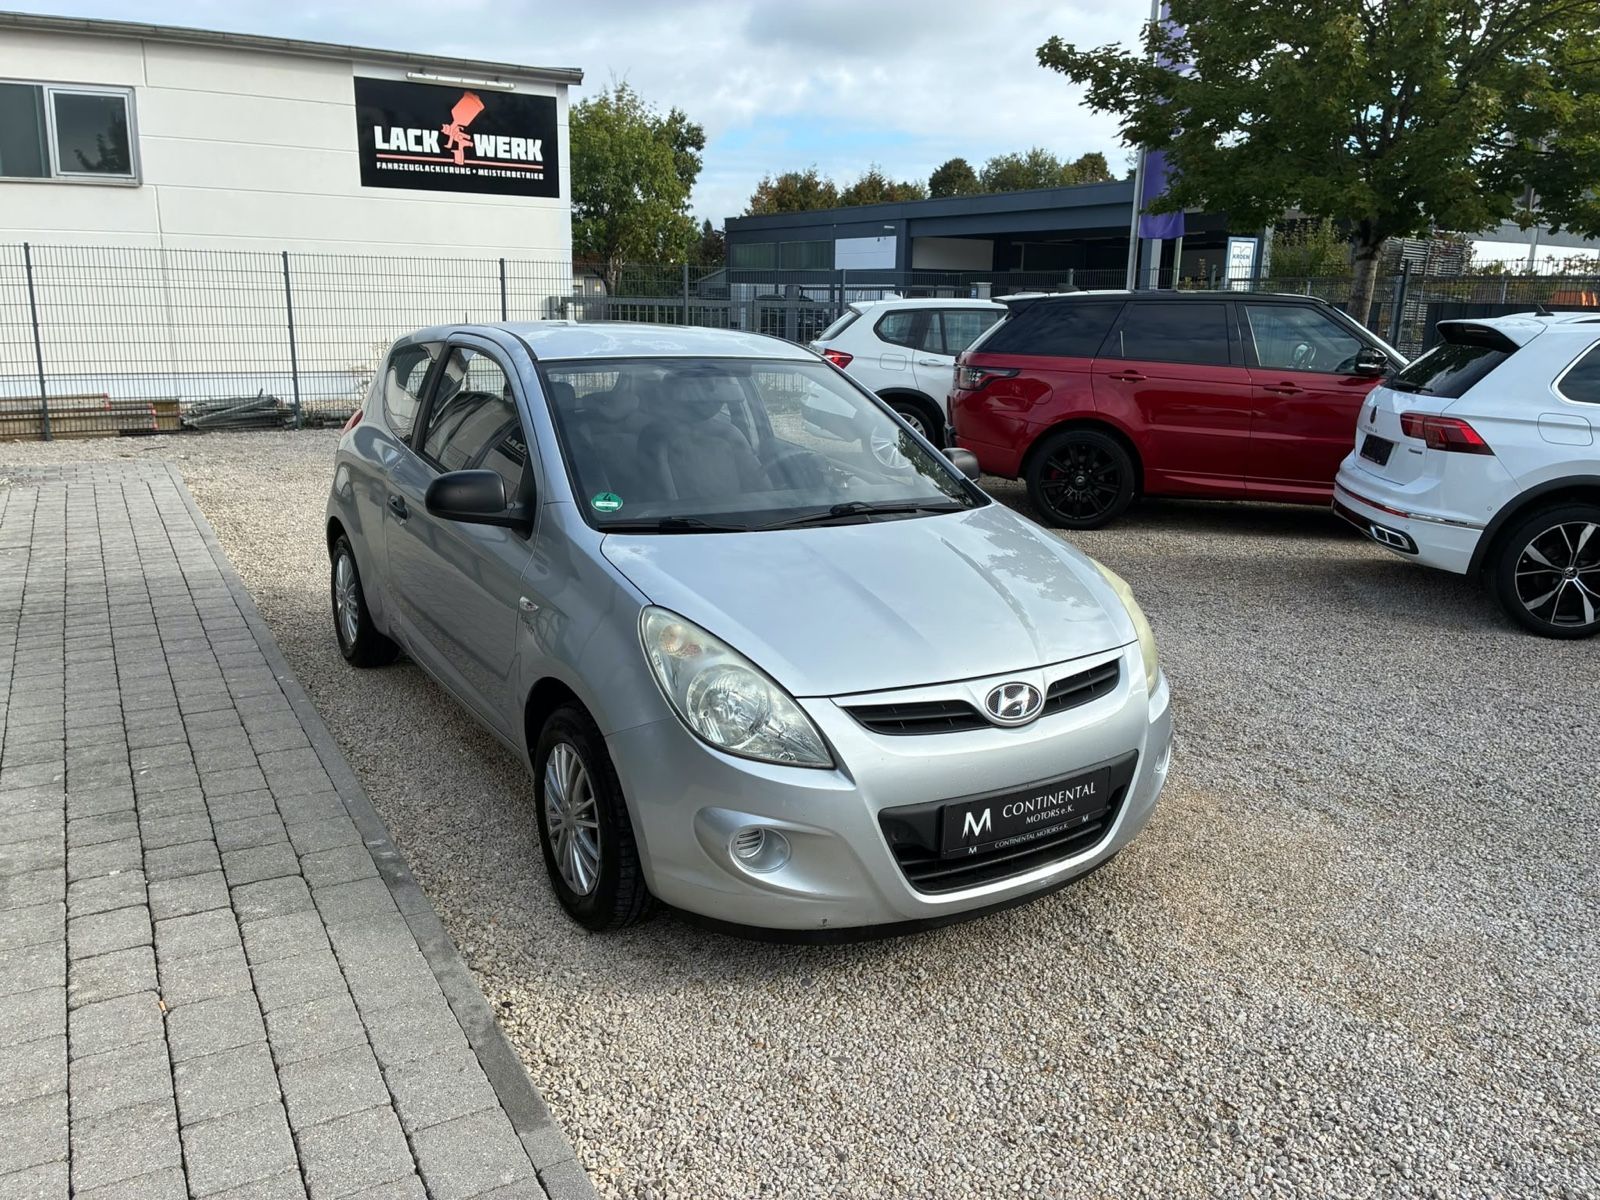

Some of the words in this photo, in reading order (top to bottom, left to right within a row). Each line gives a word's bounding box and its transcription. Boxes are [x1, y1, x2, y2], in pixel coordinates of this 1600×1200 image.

[374, 125, 440, 153] LACK
[473, 133, 543, 162] WERK
[376, 161, 471, 175] FAHRZEUGLACKIERUNG
[478, 168, 544, 180] MEISTERBETRIEB
[602, 493, 611, 502] 4
[1002, 781, 1096, 818] CONTINENTAL
[961, 807, 992, 839] M
[1026, 808, 1060, 824] MOTORS
[994, 832, 1035, 849] CONTINENTAL
[1036, 827, 1058, 838] MOTORS
[968, 846, 977, 854] M
